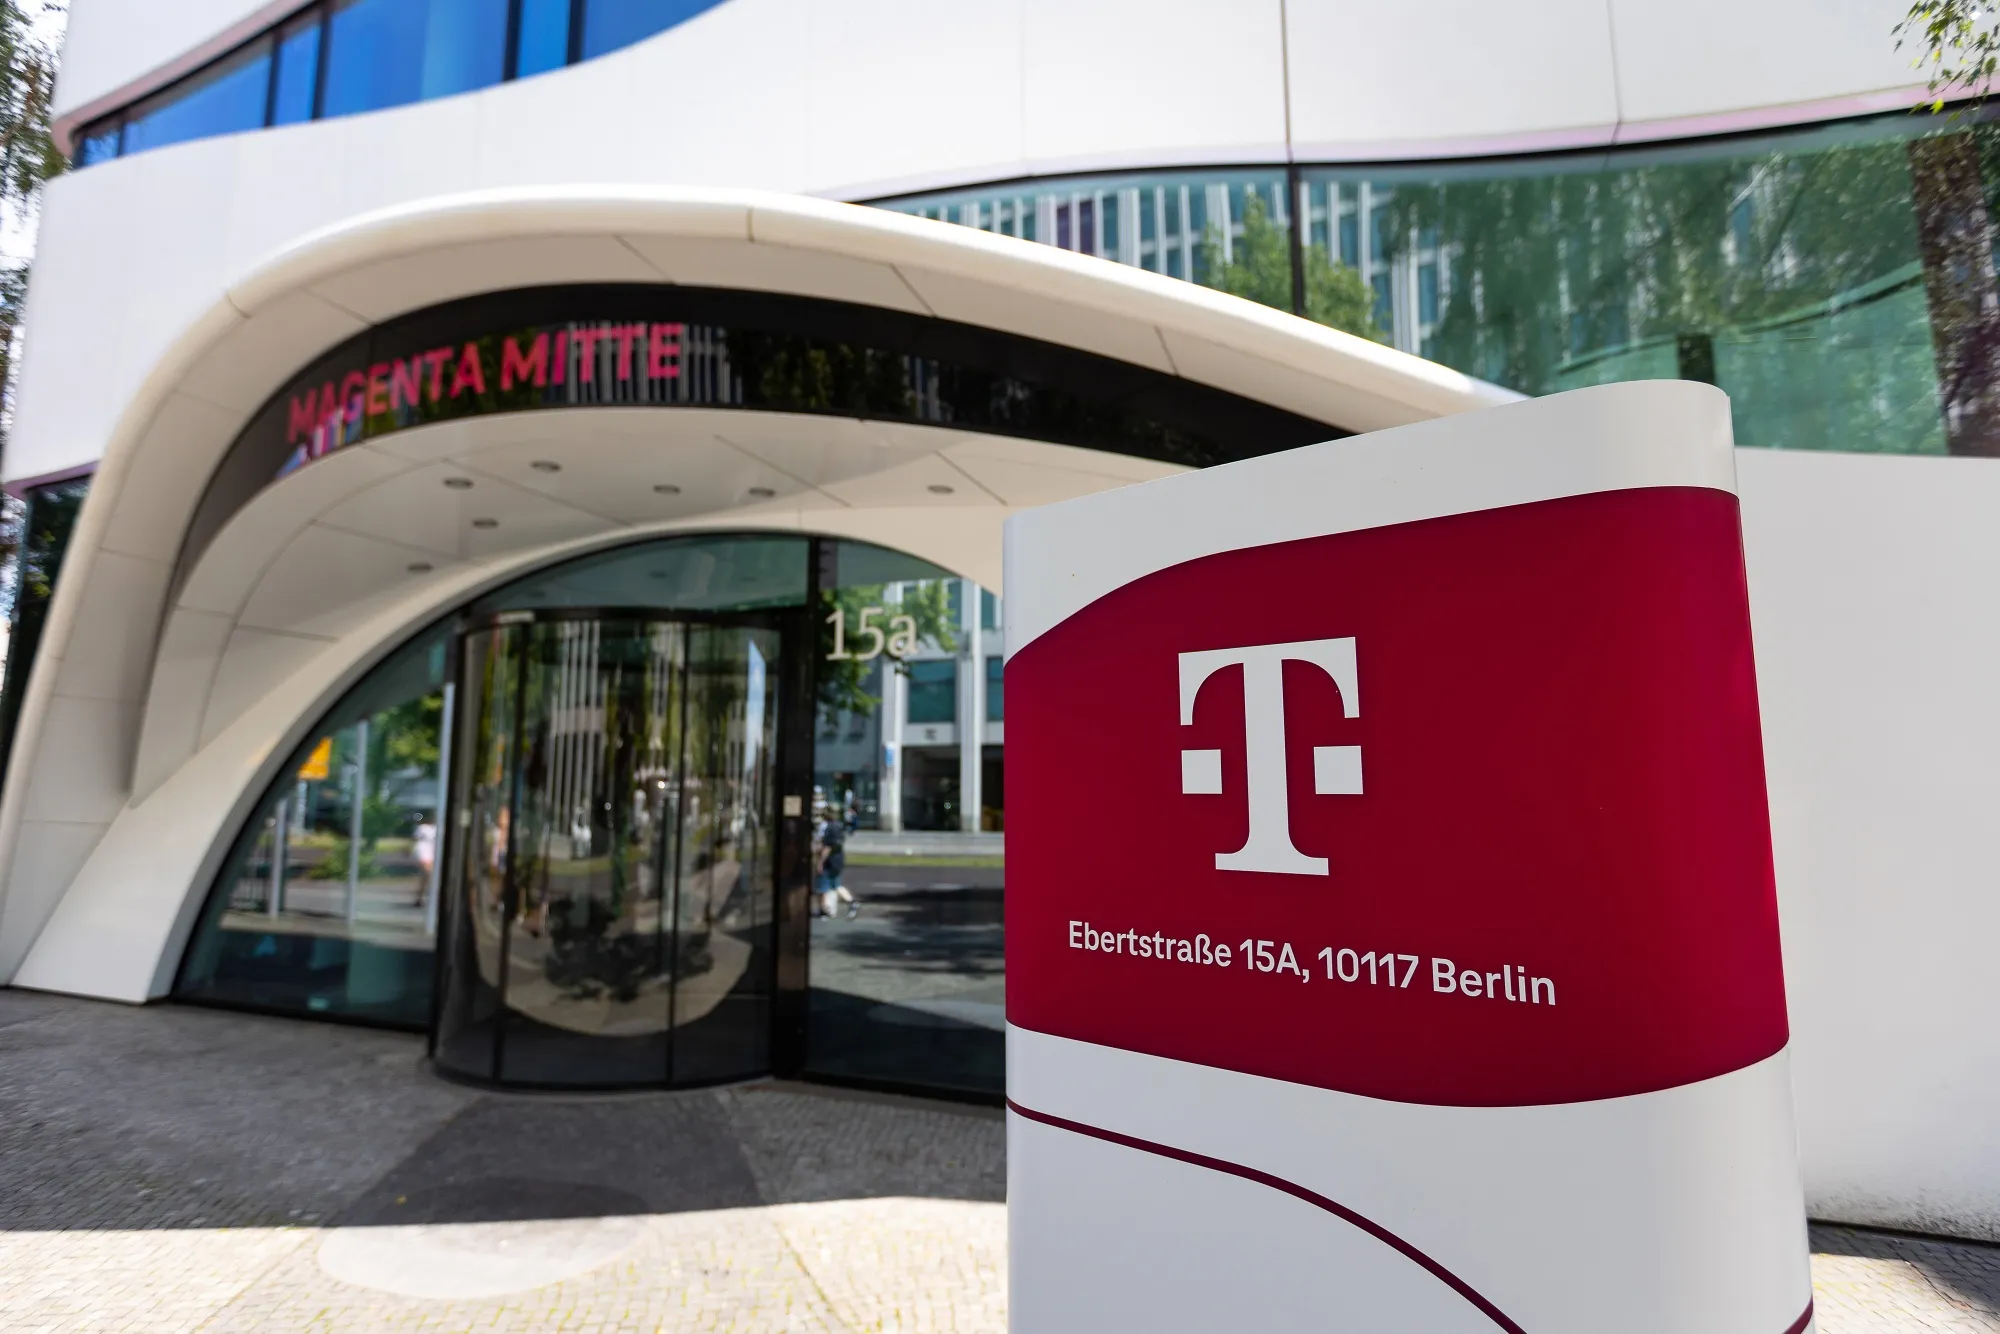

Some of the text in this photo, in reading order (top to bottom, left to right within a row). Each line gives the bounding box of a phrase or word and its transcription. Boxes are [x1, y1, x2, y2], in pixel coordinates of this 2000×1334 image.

[287, 322, 683, 444] MAGENTA MITTE
[825, 606, 919, 661] 15a
[1178, 636, 1364, 876] T
[1069, 920, 1556, 1006] Ebertstraße 15A, 10117 Berlin
